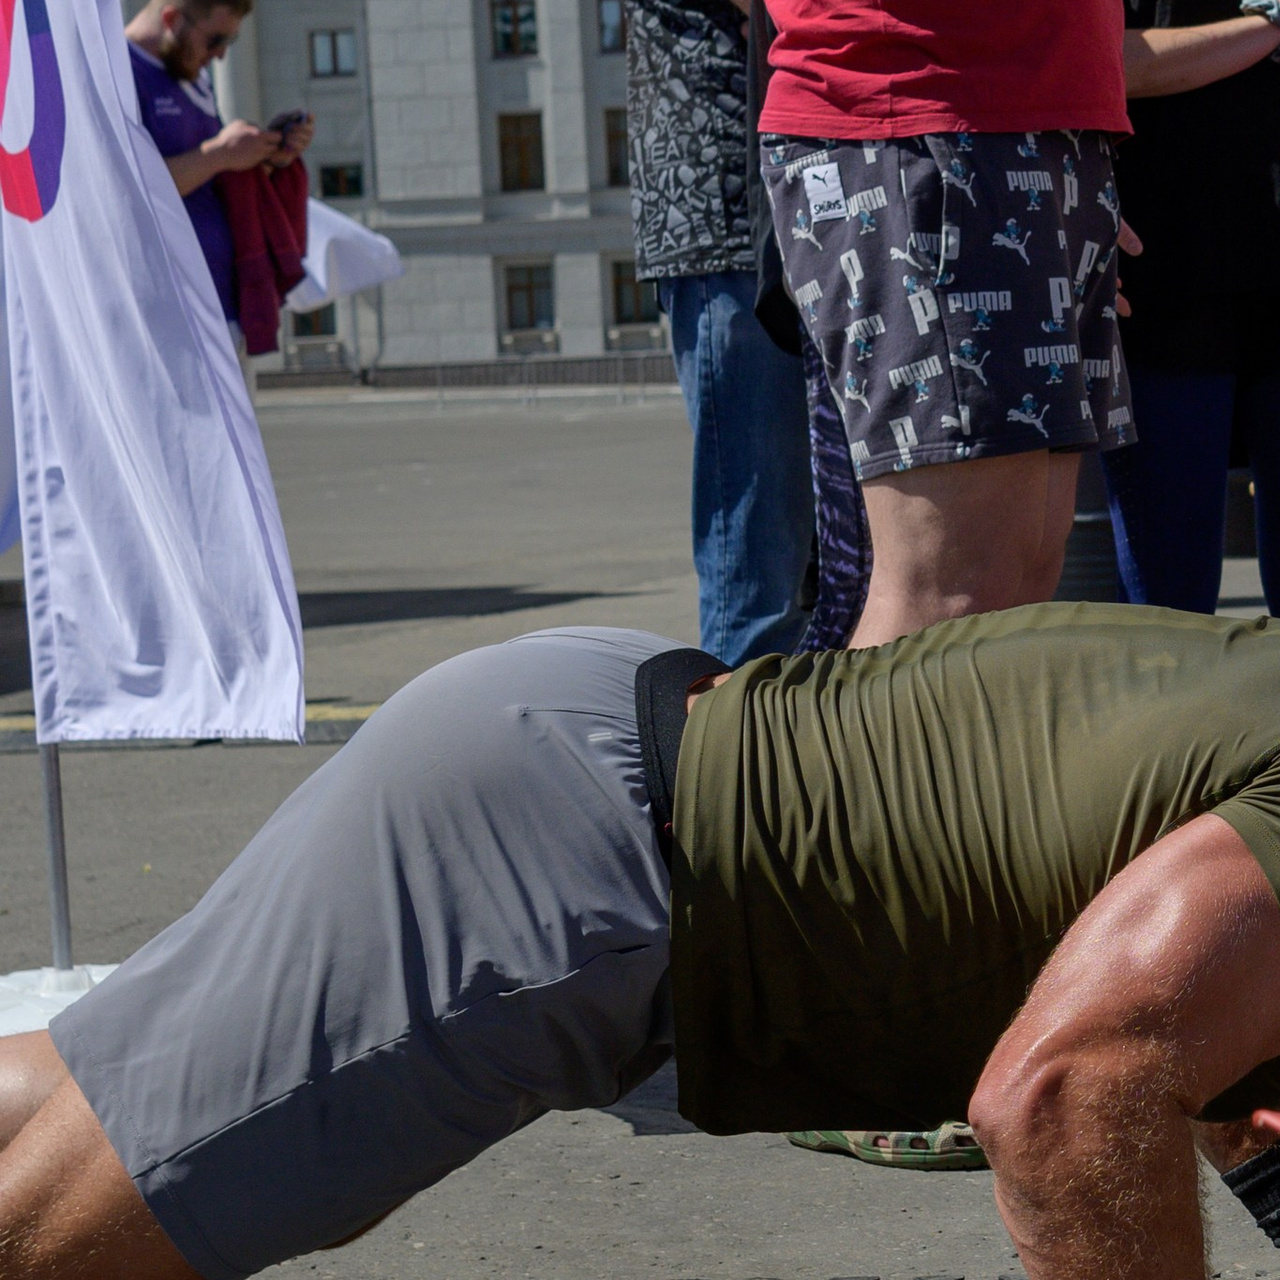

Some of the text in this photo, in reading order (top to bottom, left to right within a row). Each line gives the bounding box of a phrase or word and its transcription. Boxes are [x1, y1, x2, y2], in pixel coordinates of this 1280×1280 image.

[1006, 171, 1054, 192] PUMA
[846, 186, 888, 221] UMA
[947, 291, 1012, 314] PUMA
[1024, 344, 1079, 368] PUMA
[888, 355, 944, 391] PUMA
